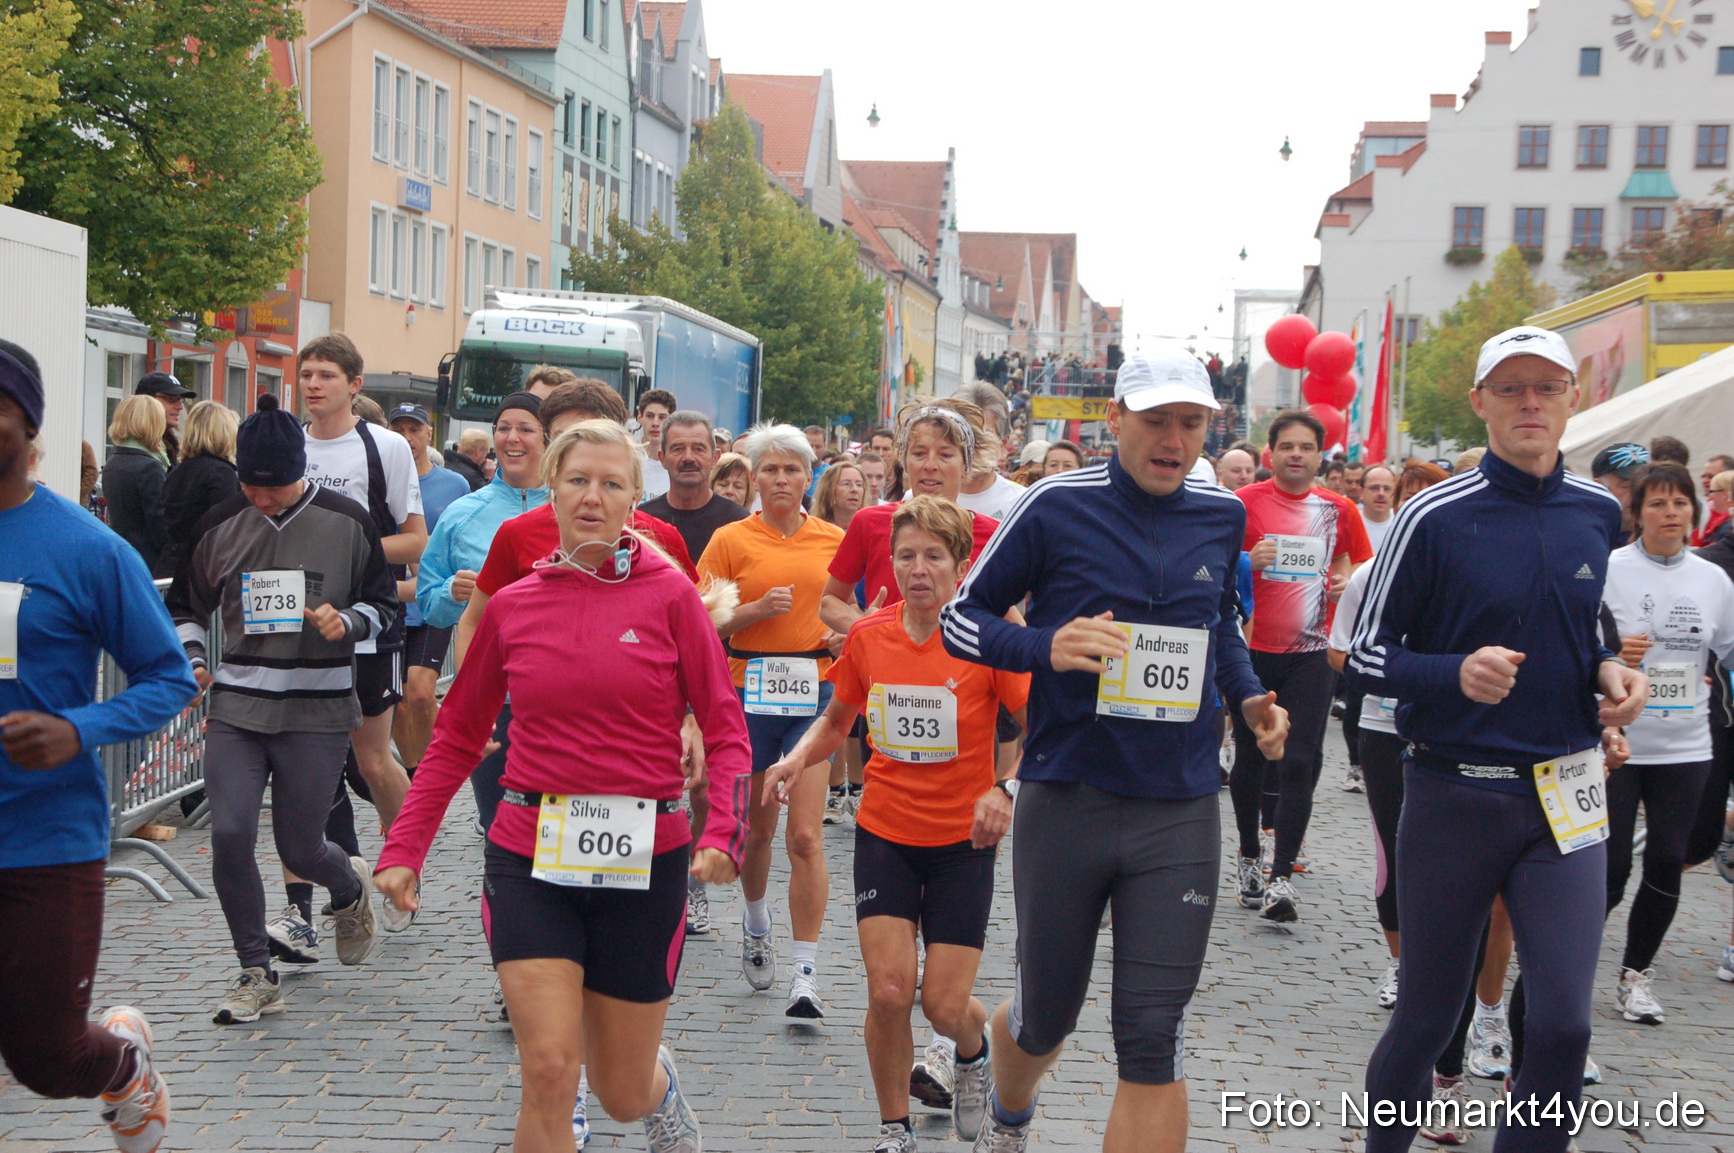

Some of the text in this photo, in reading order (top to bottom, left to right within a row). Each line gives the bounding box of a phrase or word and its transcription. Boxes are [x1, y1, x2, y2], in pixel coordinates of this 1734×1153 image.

[504, 317, 586, 336] BOCK
[1281, 553, 1316, 567] 2986
[251, 578, 281, 589] Robert
[254, 594, 297, 612] 2738
[1135, 633, 1189, 655] Andreas
[767, 662, 790, 675] Wally
[1106, 657, 1114, 671] C
[749, 677, 755, 685] C
[1143, 663, 1190, 691] 605
[767, 679, 810, 695] 3046
[1649, 684, 1687, 698] 3091
[888, 692, 942, 709] Marianne
[869, 712, 875, 723] C
[897, 716, 941, 739] 353
[1559, 762, 1588, 782] Artur
[570, 800, 610, 820] Silvia
[541, 825, 549, 838] C
[578, 829, 633, 857] 606
[604, 873, 648, 883] PFLEIDERER
